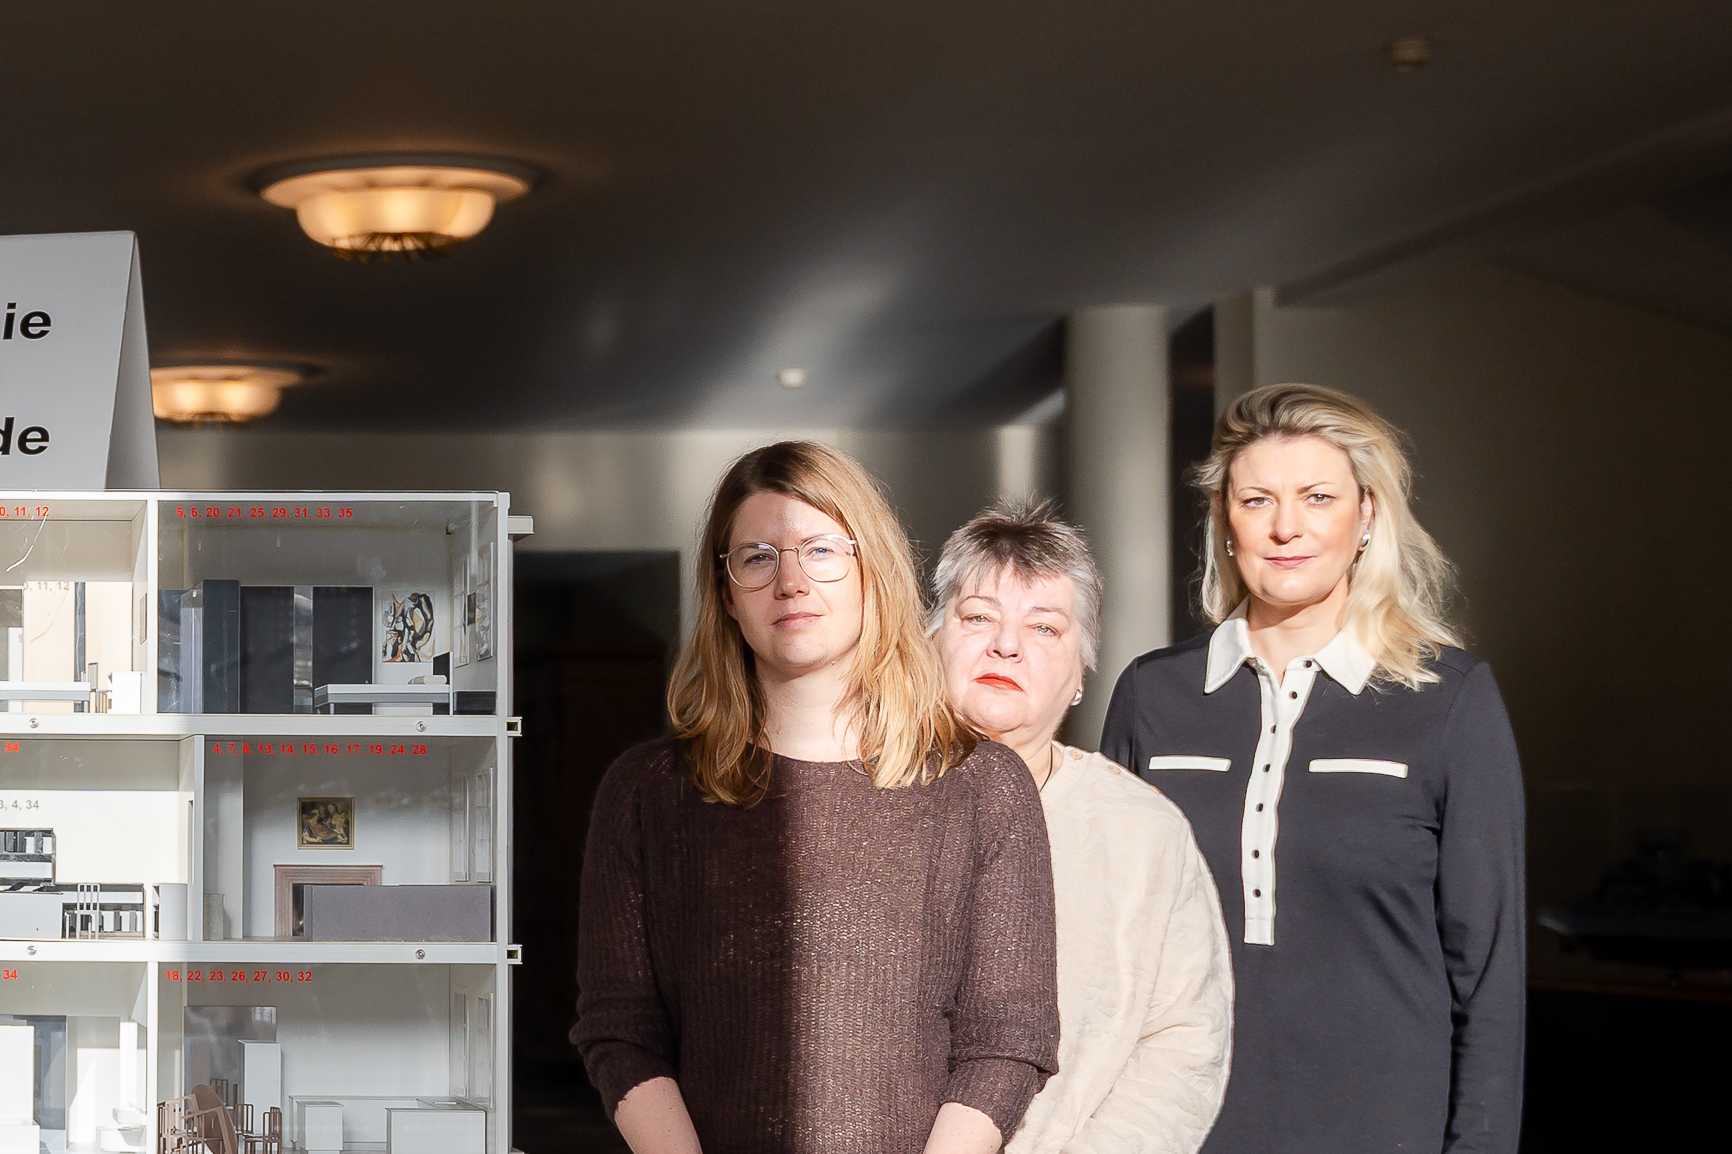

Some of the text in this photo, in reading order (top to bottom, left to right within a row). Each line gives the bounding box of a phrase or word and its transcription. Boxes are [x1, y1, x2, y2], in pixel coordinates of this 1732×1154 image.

[14, 506, 30, 518] 11,
[35, 506, 49, 516] 12
[176, 507, 353, 519] 5, 6, 20, 21, 25, 29, 31, 33, 35
[4, 741, 20, 752] 34
[212, 744, 427, 756] 4, 7, 8, 13, 14, 15, 16, 17, 19, 24, 28
[3, 969, 18, 980] 34
[165, 970, 312, 983] 18, 22, 23, 26, 27, 30, 32
